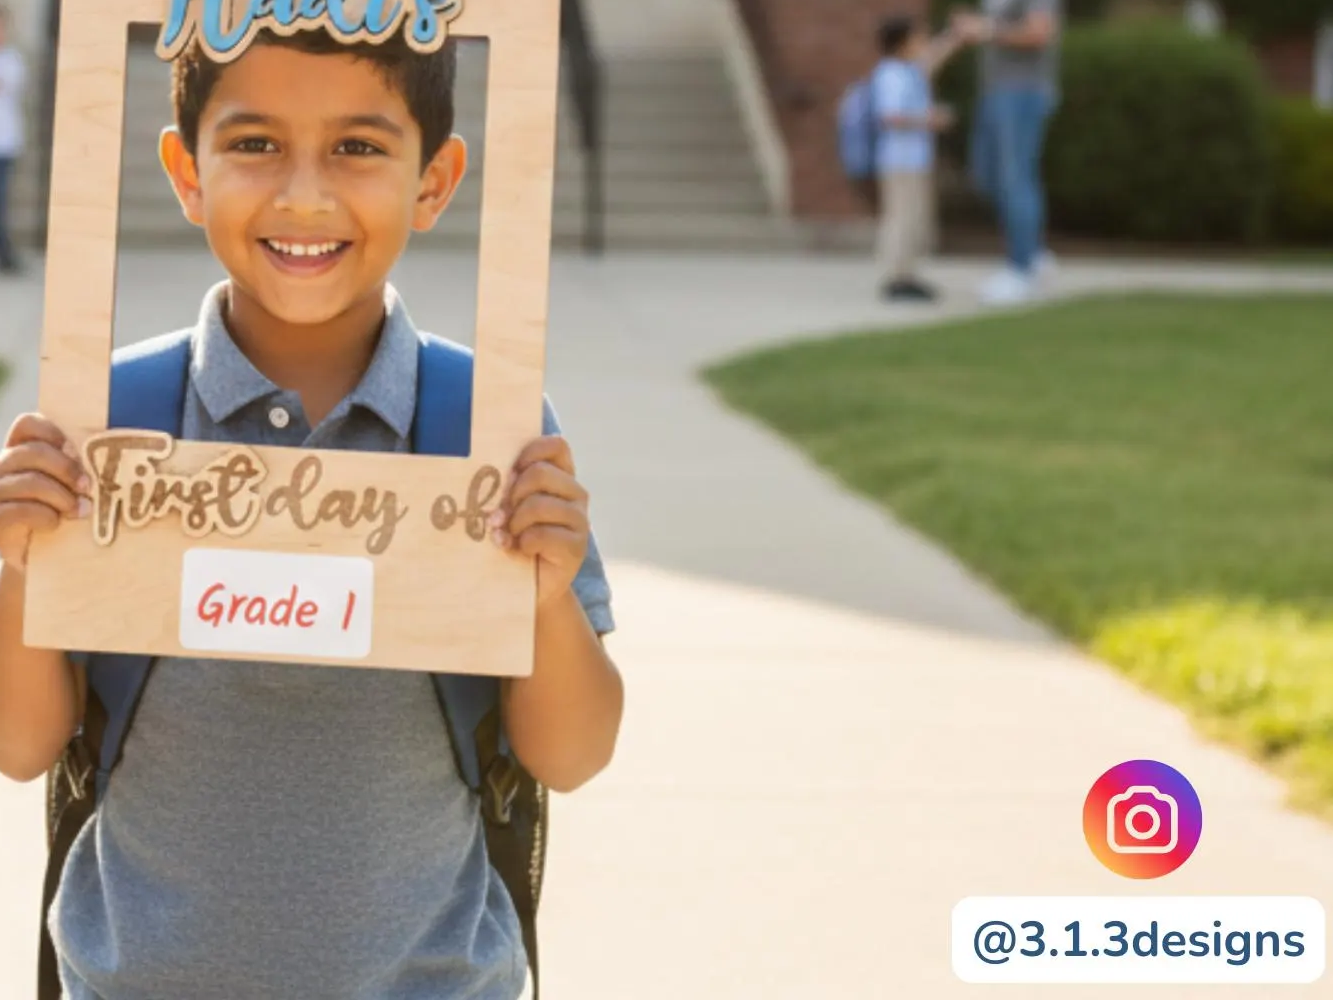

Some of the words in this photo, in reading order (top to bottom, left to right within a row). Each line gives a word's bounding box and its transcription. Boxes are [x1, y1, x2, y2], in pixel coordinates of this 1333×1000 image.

[86, 434, 261, 541] First
[266, 455, 409, 555] day
[429, 465, 502, 542] of
[196, 582, 319, 628] Grade
[340, 590, 357, 631] 1
